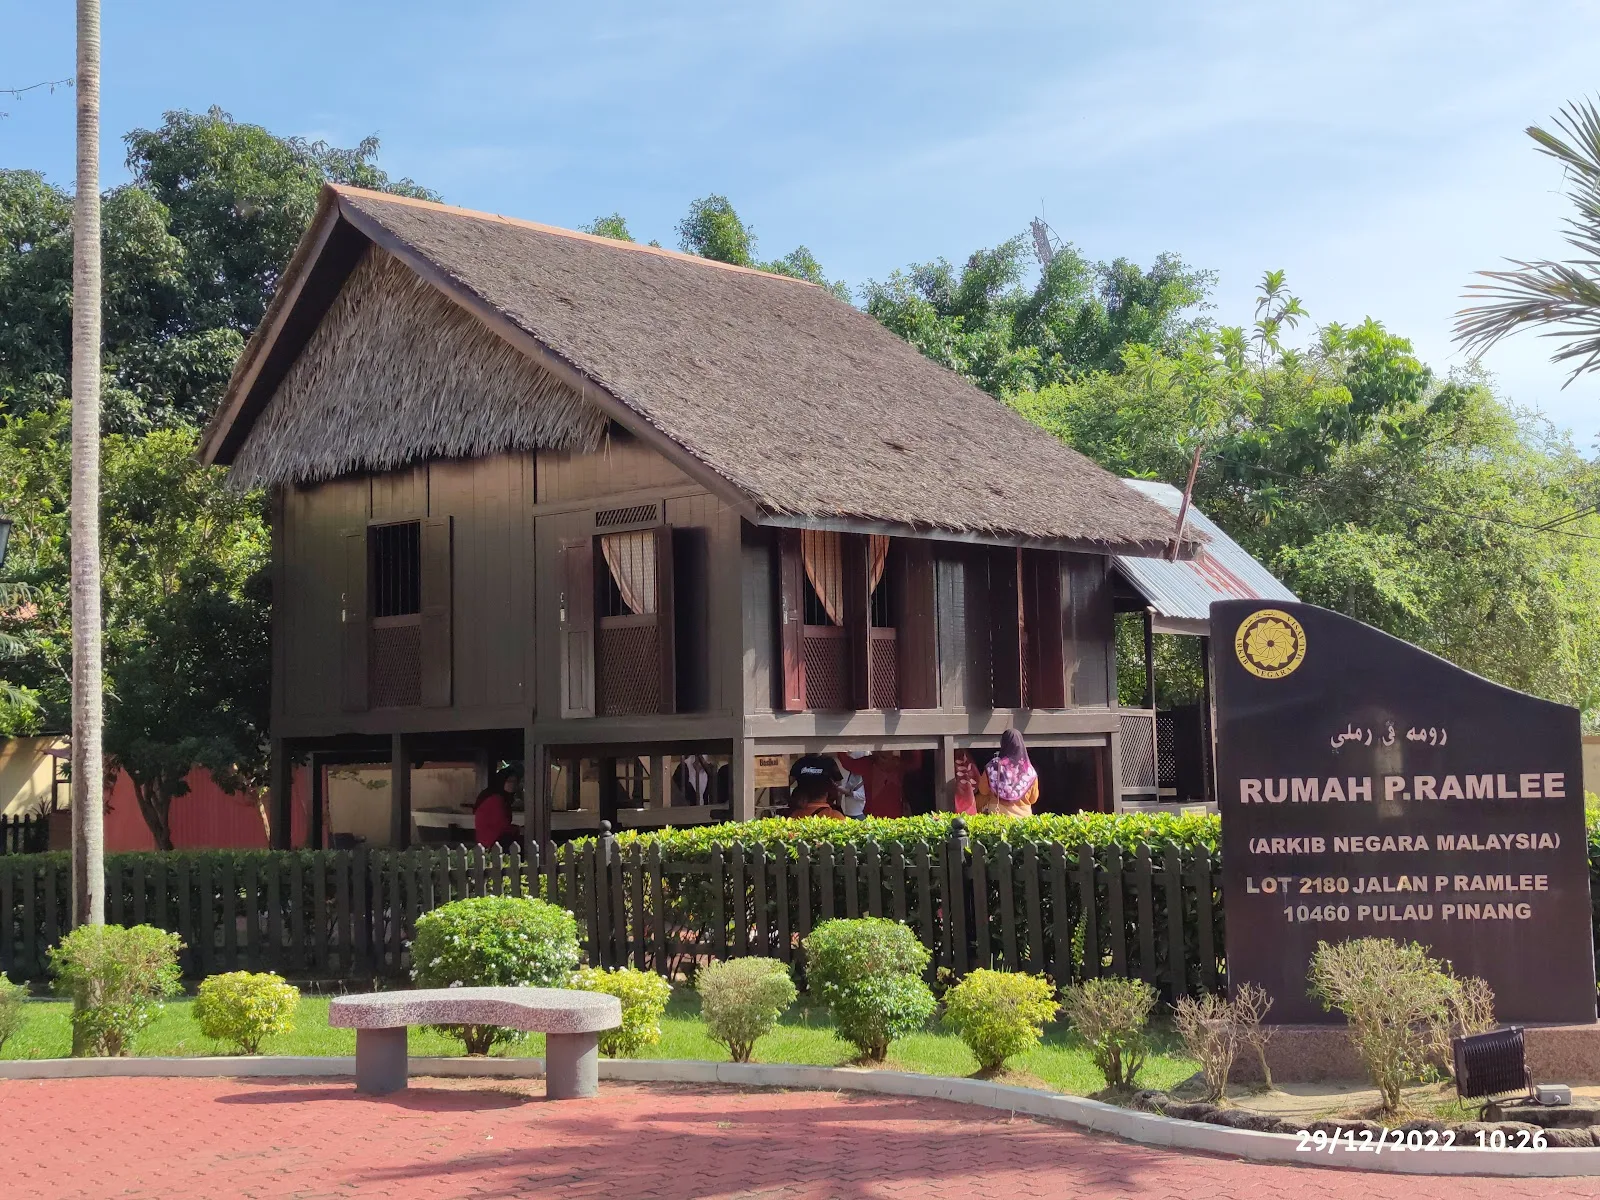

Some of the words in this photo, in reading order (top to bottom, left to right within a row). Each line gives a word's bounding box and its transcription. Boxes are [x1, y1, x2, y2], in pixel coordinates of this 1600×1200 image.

[1239, 776, 1373, 804] RUMAH
[1384, 772, 1566, 801] P.RAMLEE
[1249, 837, 1326, 854] (ARKIB
[1333, 835, 1429, 853] NEGARA
[1436, 832, 1561, 851] MALAYSIA)
[1246, 876, 1292, 894] LOT
[1299, 876, 1350, 894] 2180
[1352, 875, 1428, 894] JALAN
[1454, 874, 1549, 891] RAMLEE
[1283, 905, 1350, 923] 10460
[1357, 904, 1434, 922] PULAU
[1441, 903, 1532, 921] PINANG
